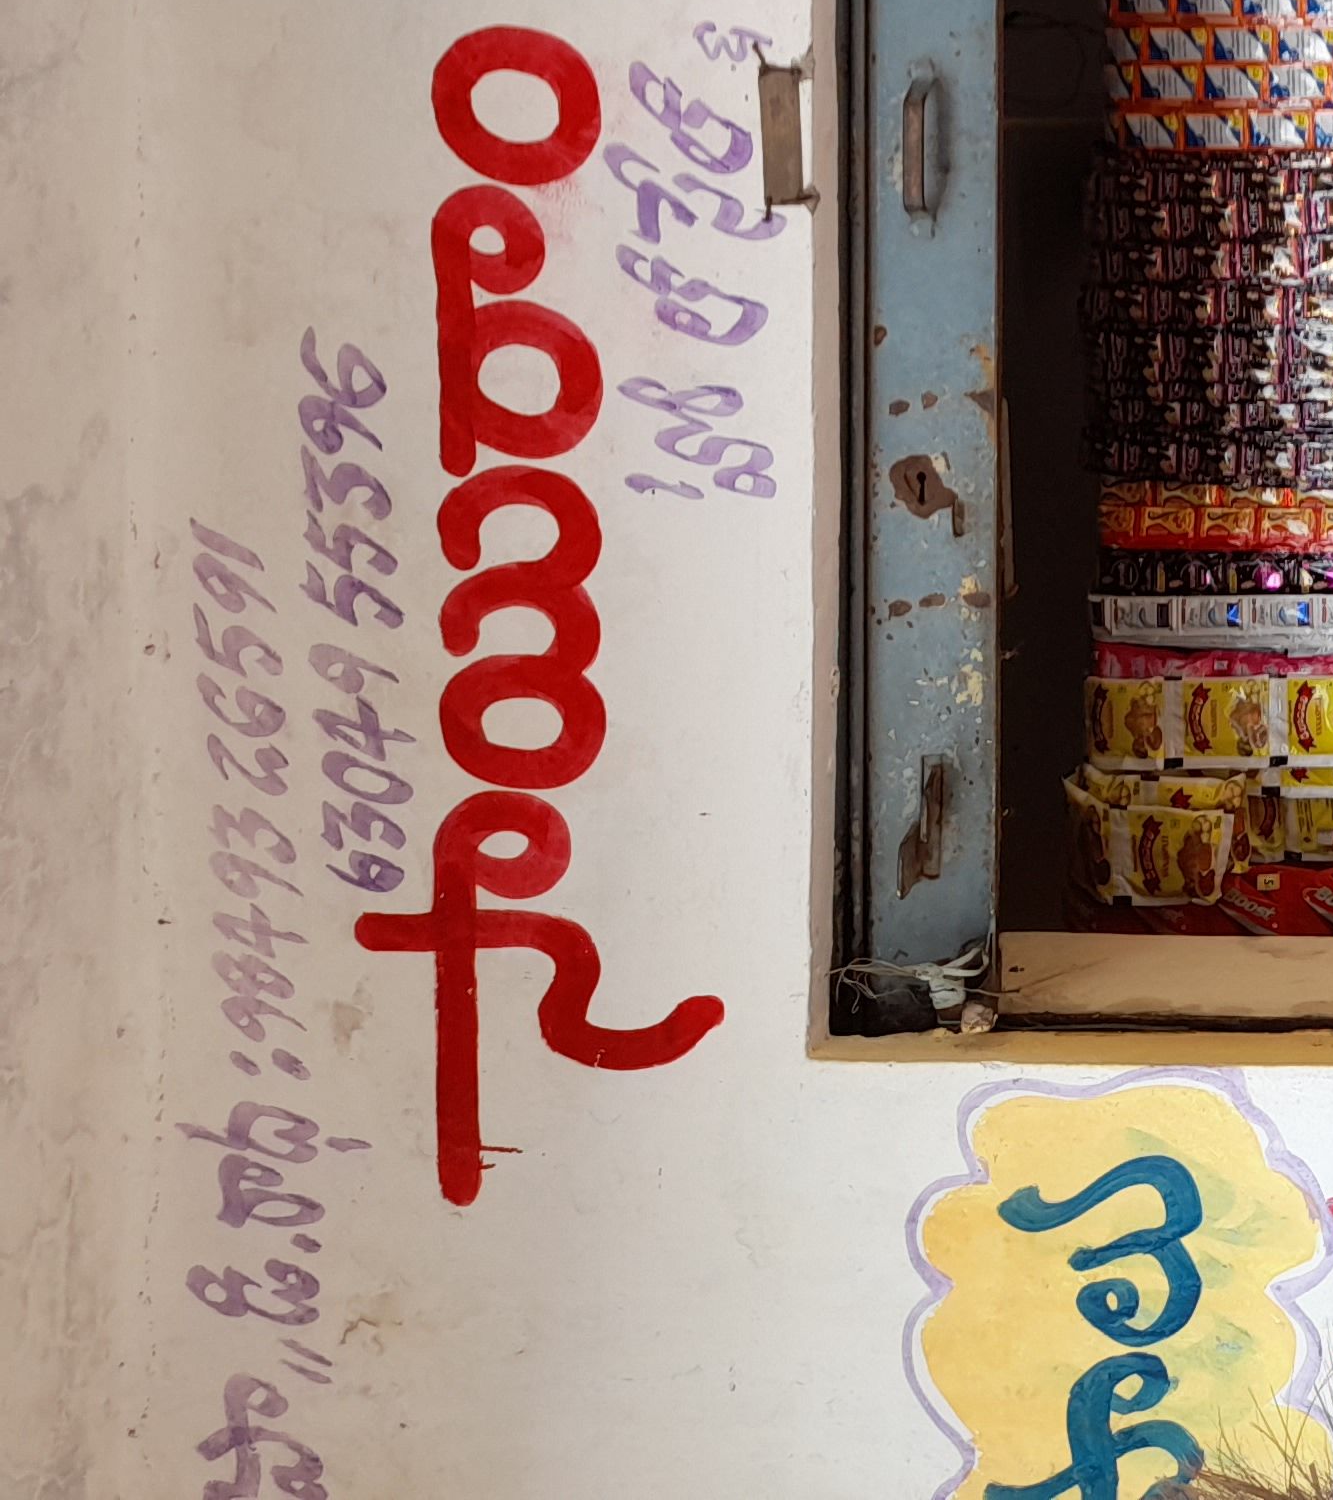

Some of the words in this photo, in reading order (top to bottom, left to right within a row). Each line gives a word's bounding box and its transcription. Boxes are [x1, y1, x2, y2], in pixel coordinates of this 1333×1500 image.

[296, 325, 406, 632] 55396
[354, 26, 725, 1206] సాయిరాం
[187, 518, 292, 793] 26591
[319, 649, 417, 894] 63049
